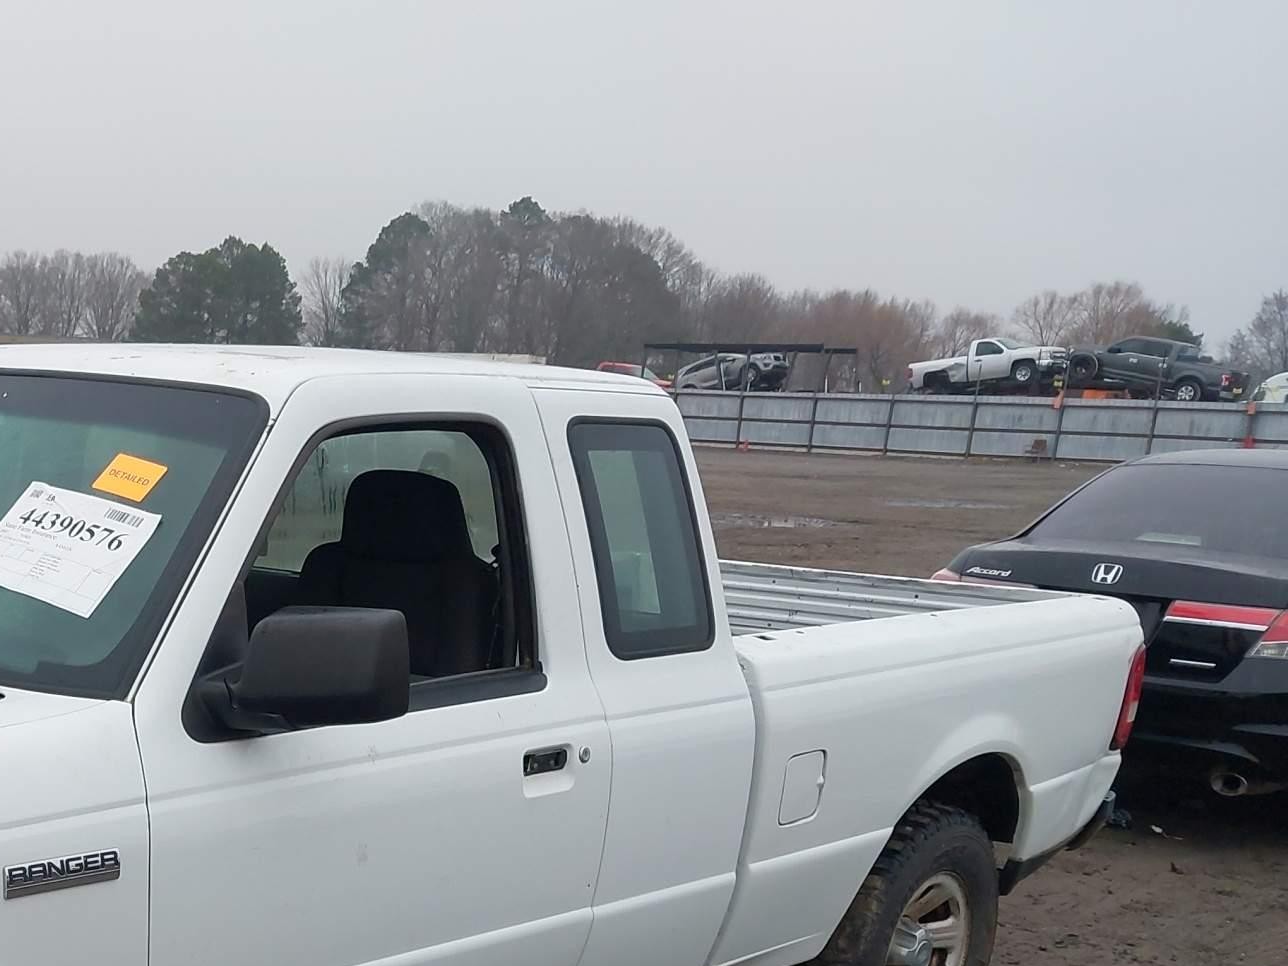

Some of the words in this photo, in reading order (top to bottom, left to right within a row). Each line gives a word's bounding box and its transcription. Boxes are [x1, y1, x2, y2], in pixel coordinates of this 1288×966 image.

[108, 467, 151, 487] DETAILED
[19, 507, 129, 551] 44390576
[966, 566, 1012, 577] Accord
[6, 849, 120, 885] RANGER
